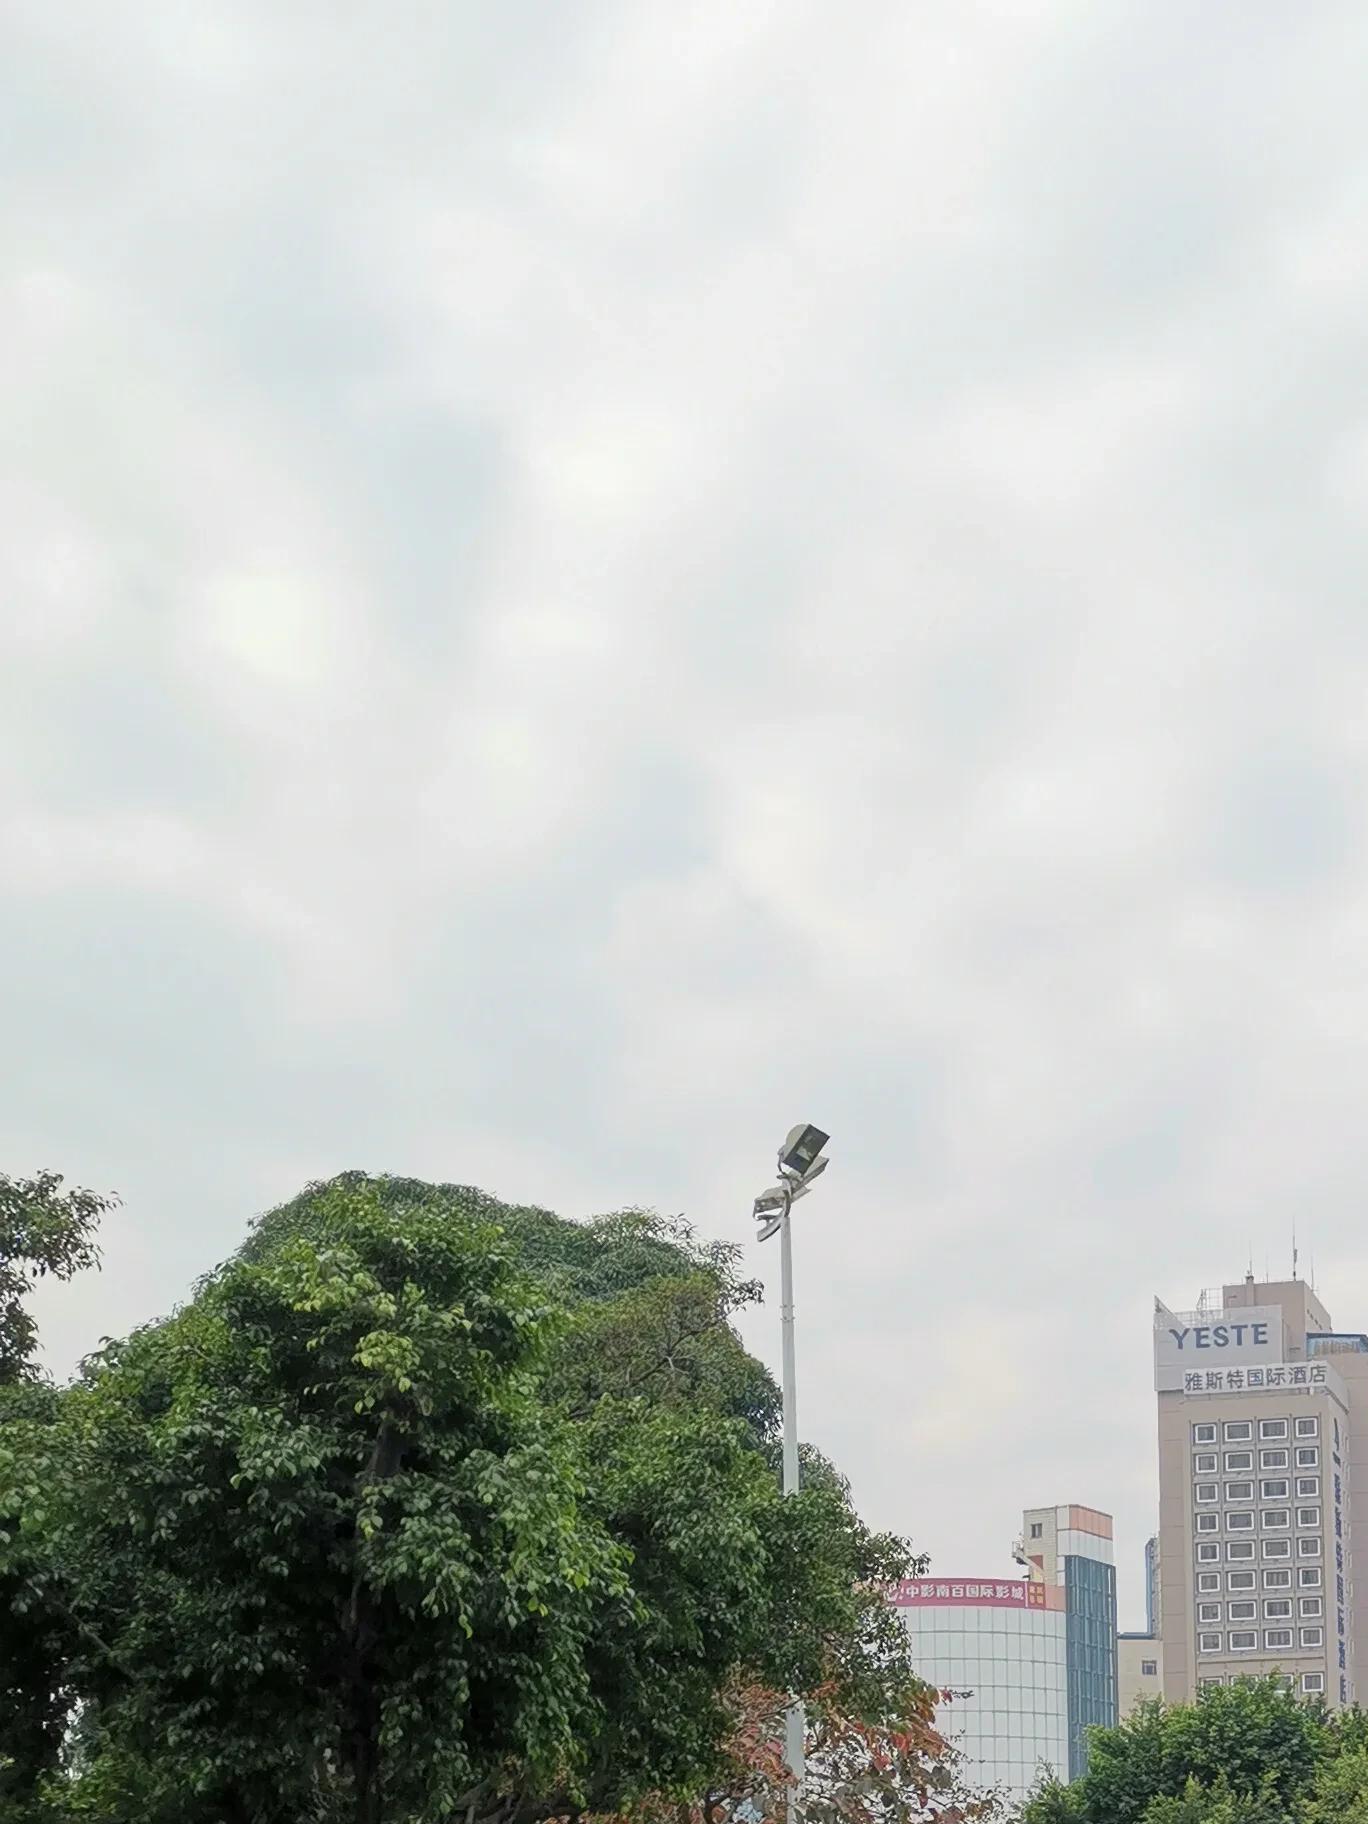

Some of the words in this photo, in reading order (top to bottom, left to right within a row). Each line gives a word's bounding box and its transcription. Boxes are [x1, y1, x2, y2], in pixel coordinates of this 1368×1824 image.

[1169, 1323, 1268, 1350] YESTE
[1184, 1365, 1327, 1391] 雅斯特国际酒店
[906, 1584, 1024, 1600] 中影南百国际影城
